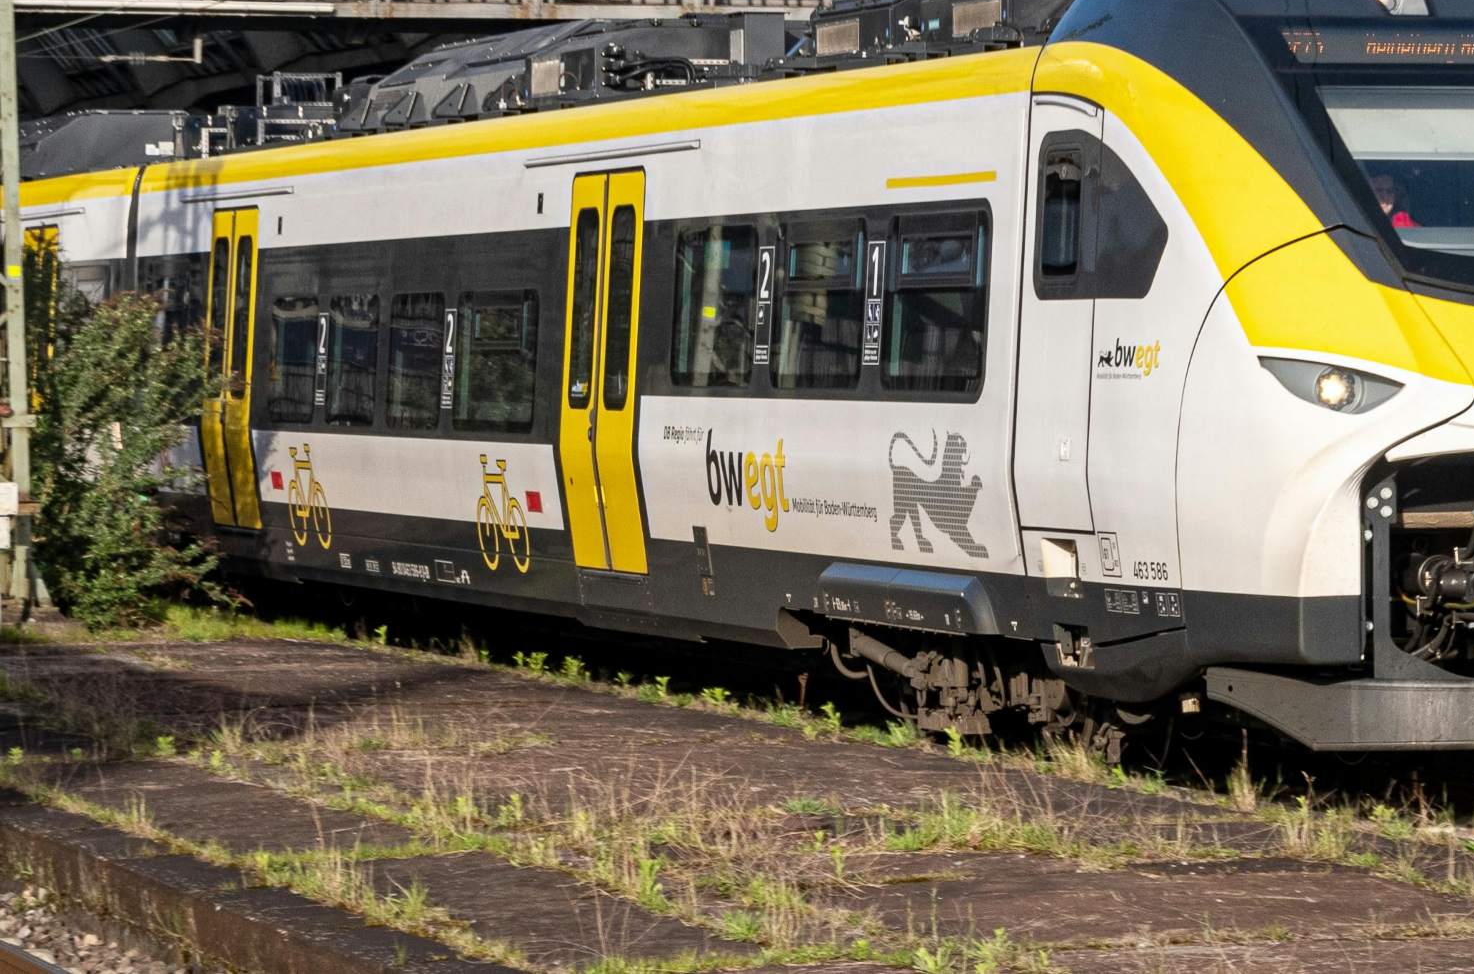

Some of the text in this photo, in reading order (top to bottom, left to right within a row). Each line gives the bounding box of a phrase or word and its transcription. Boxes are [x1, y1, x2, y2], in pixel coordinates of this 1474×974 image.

[760, 251, 771, 299] 2
[872, 246, 880, 297] 1
[318, 316, 327, 354] 2
[446, 313, 454, 353] 2
[1115, 337, 1161, 377] bwegt
[705, 428, 790, 533] bwegt
[1133, 561, 1169, 581] 463 586
